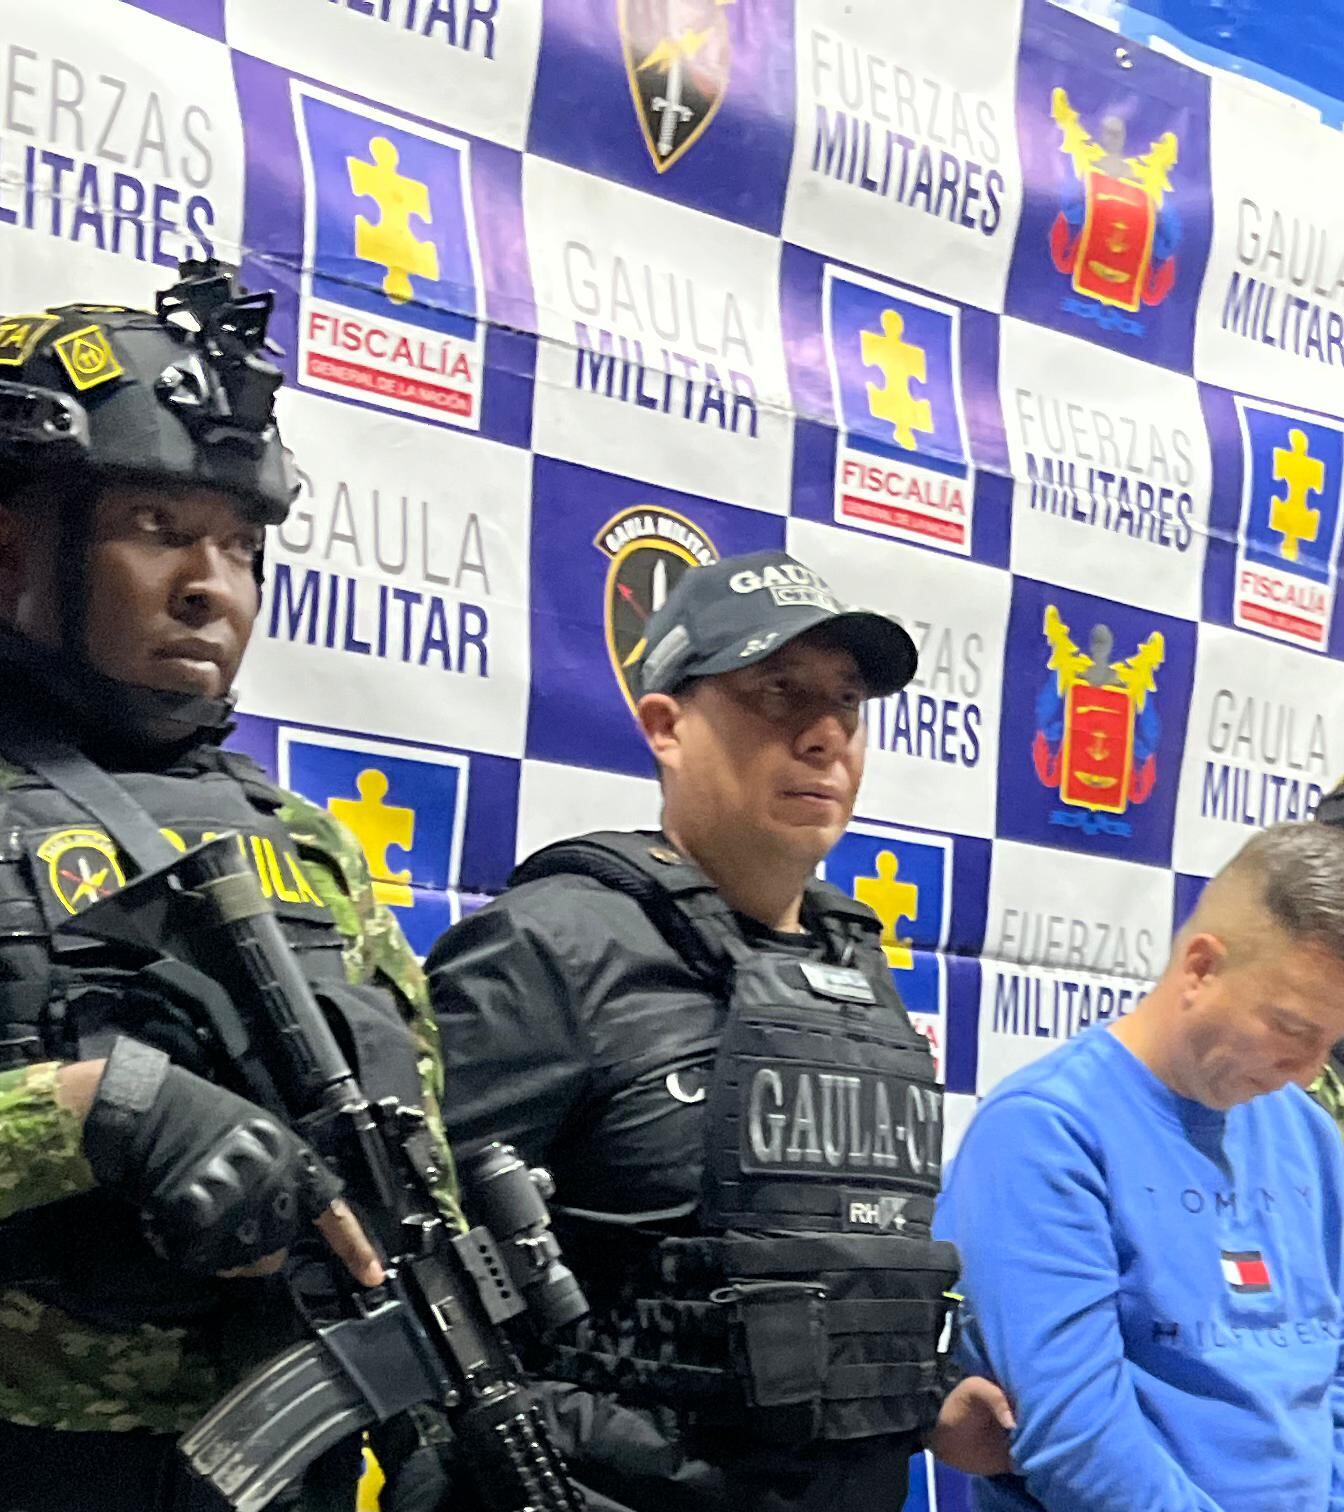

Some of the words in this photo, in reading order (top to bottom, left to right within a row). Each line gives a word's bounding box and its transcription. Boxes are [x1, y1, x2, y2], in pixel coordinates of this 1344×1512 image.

[811, 31, 1002, 165] FUERZAS
[811, 105, 1004, 237] MILITARES
[308, 312, 473, 384] FISCALÍA
[563, 241, 754, 367] GAULA
[574, 320, 759, 439] MILITAR
[841, 459, 967, 517] FISCALÍA
[1014, 387, 1196, 489] FUERZAS
[277, 466, 493, 595] GAULA
[1024, 452, 1195, 553] MILITARES
[267, 563, 490, 679] MILITAR
[1207, 689, 1330, 777] GAULA
[995, 907, 1156, 984] FUERZAS
